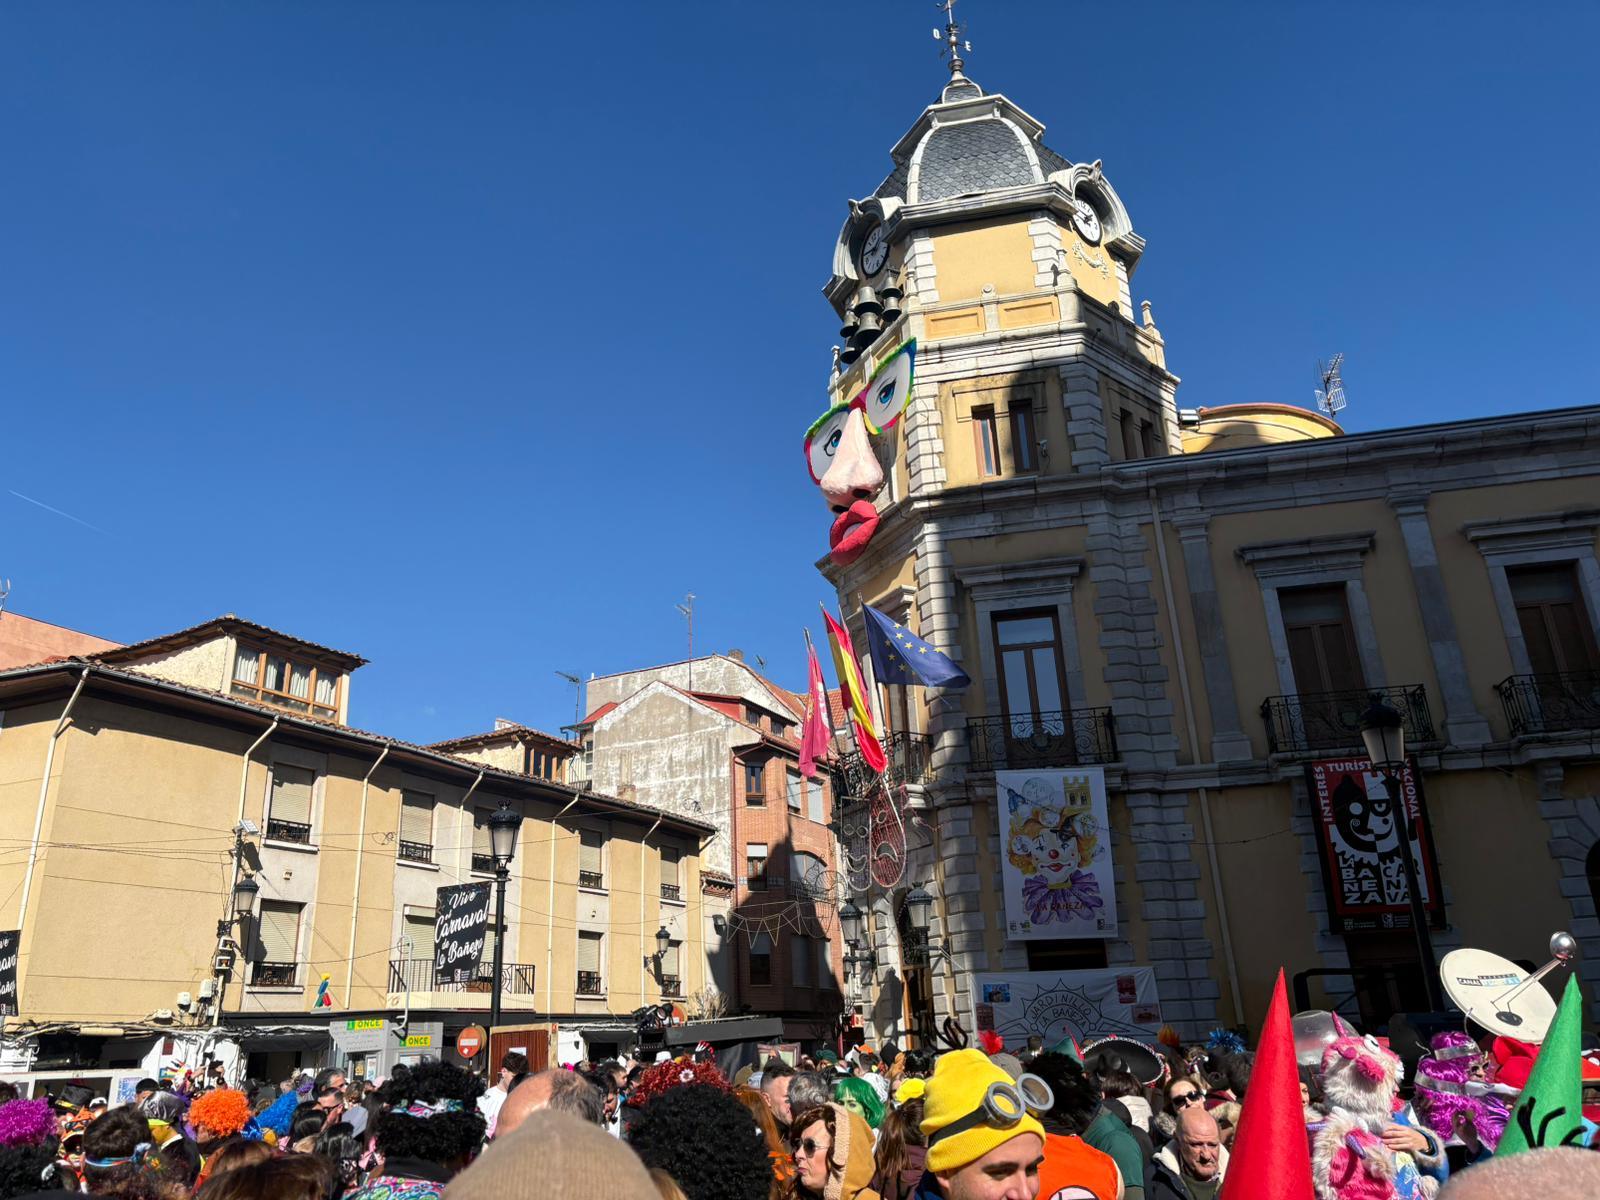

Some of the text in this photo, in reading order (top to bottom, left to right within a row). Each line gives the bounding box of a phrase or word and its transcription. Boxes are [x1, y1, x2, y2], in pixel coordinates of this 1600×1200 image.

[1339, 856, 1355, 868] LA
[449, 891, 476, 910] Vive
[434, 899, 490, 944] Carnaval
[442, 939, 451, 950] de
[436, 938, 484, 970] La Bañeza
[1030, 994, 1092, 1020] JARDINILLO
[357, 1019, 381, 1028] ONCE
[408, 1036, 428, 1045] ONCE
